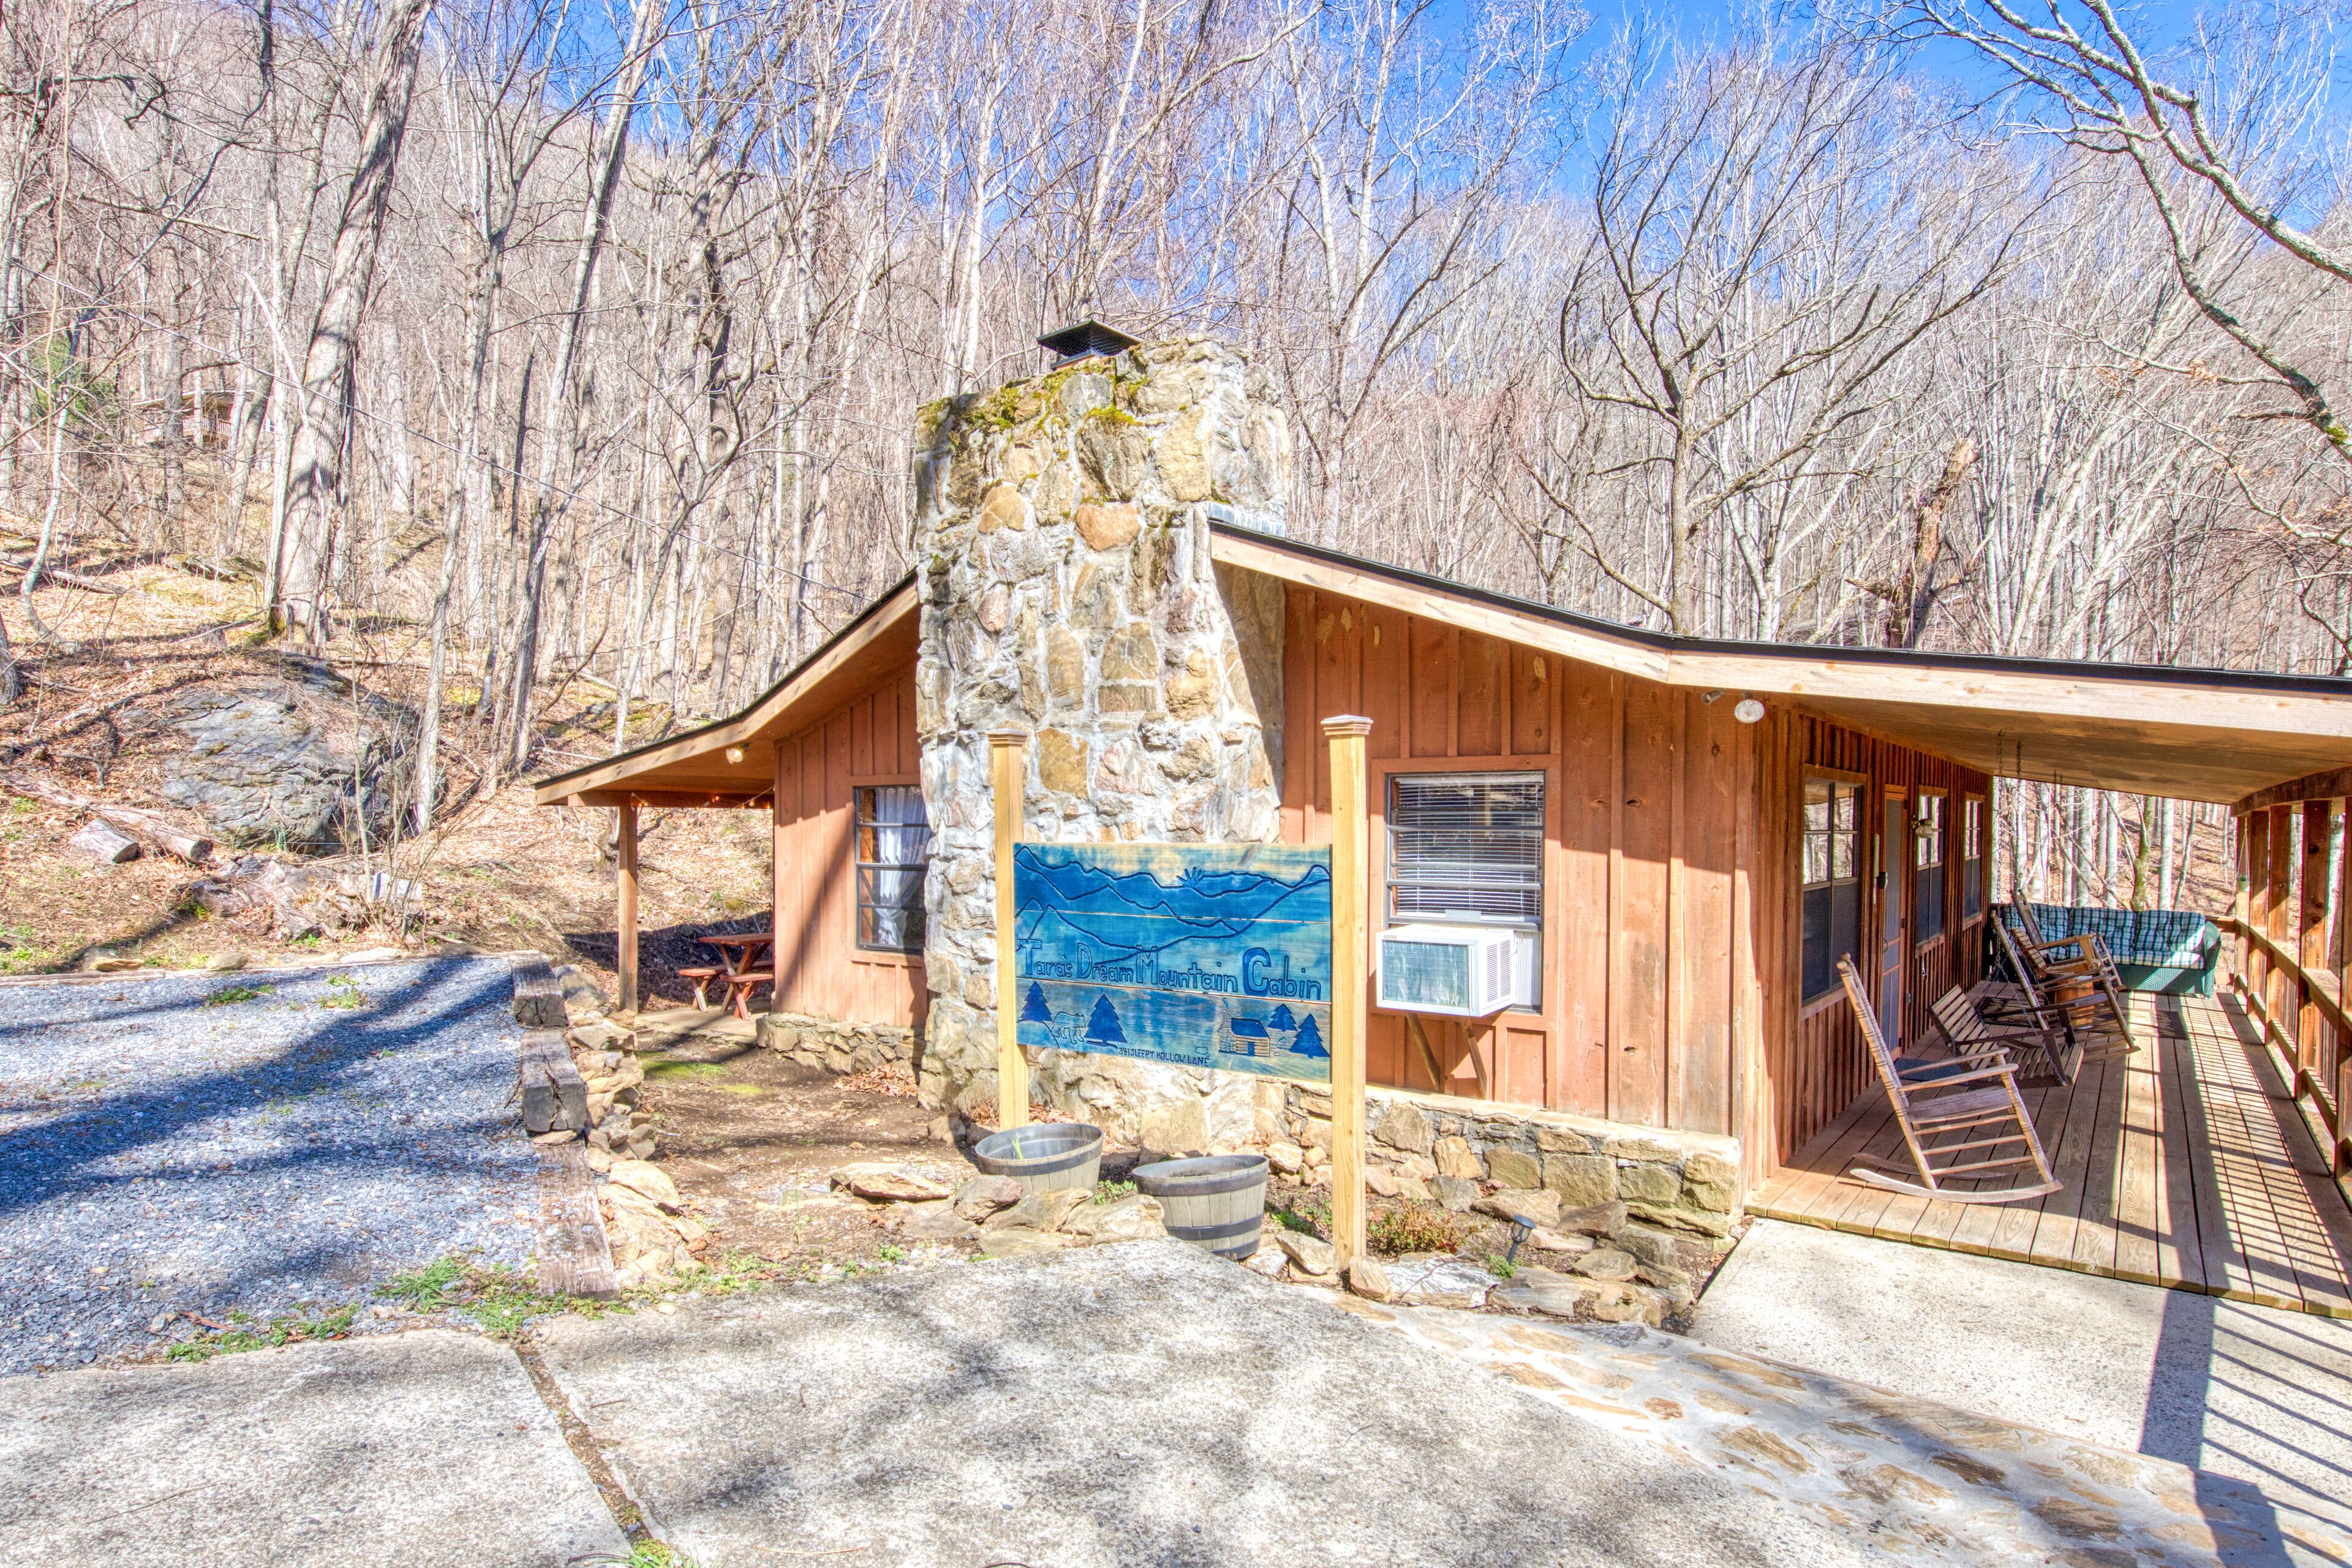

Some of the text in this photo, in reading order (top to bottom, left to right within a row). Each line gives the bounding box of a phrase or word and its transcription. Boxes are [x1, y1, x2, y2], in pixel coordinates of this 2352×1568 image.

[1077, 942, 1133, 982] Dream
[1136, 944, 1238, 992] Mountain
[1243, 947, 1322, 1000] Cabin
[1130, 1049, 1155, 1058] SLEEPY
[1156, 1051, 1186, 1063] HOLLOW
[1187, 1055, 1210, 1067] LANE
